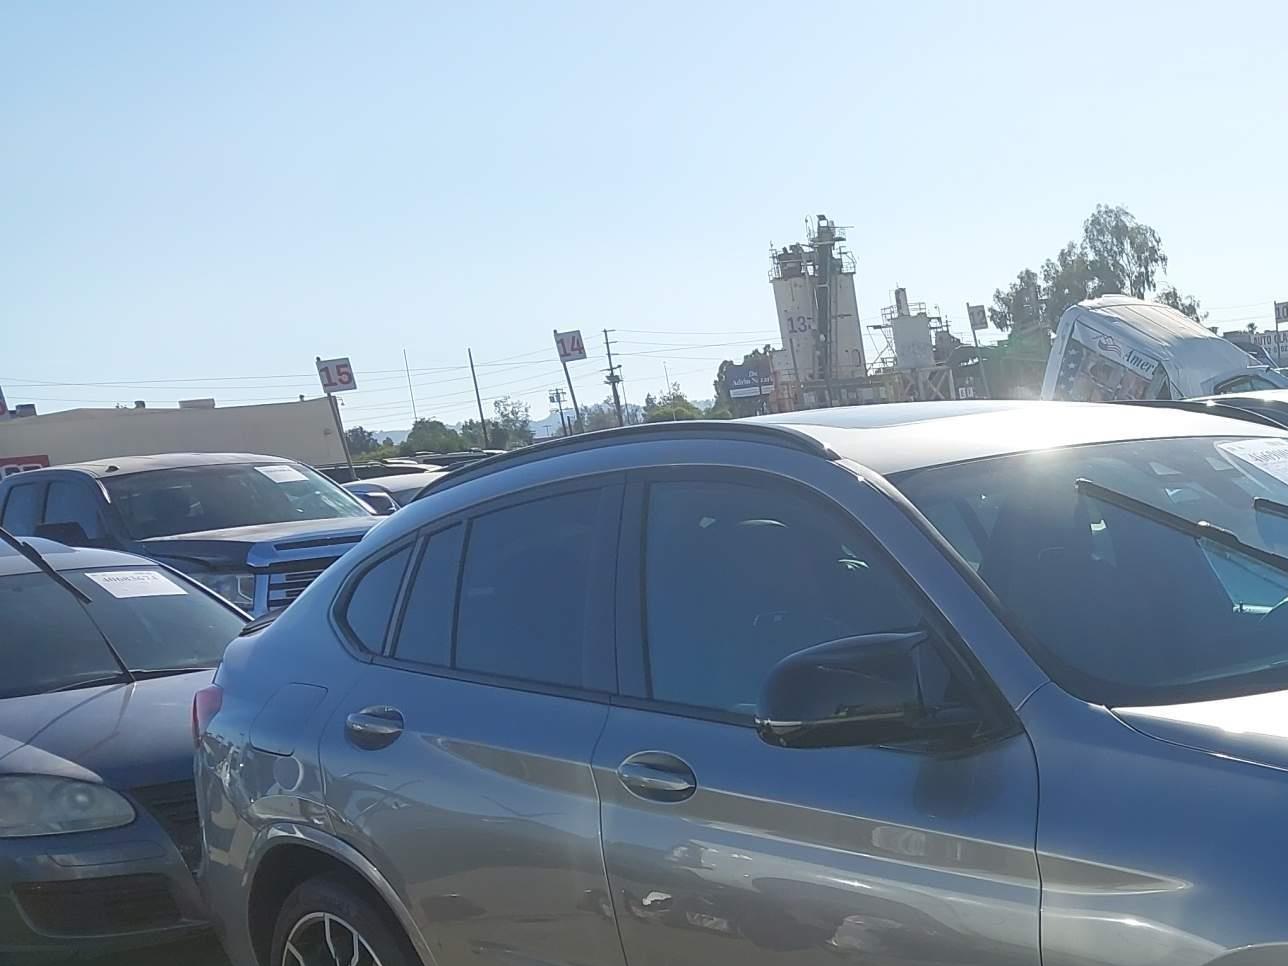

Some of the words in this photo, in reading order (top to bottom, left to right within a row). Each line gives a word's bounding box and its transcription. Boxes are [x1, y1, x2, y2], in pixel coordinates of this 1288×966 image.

[1276, 305, 1288, 321] 10
[557, 335, 585, 357] 14
[320, 363, 353, 387] 15
